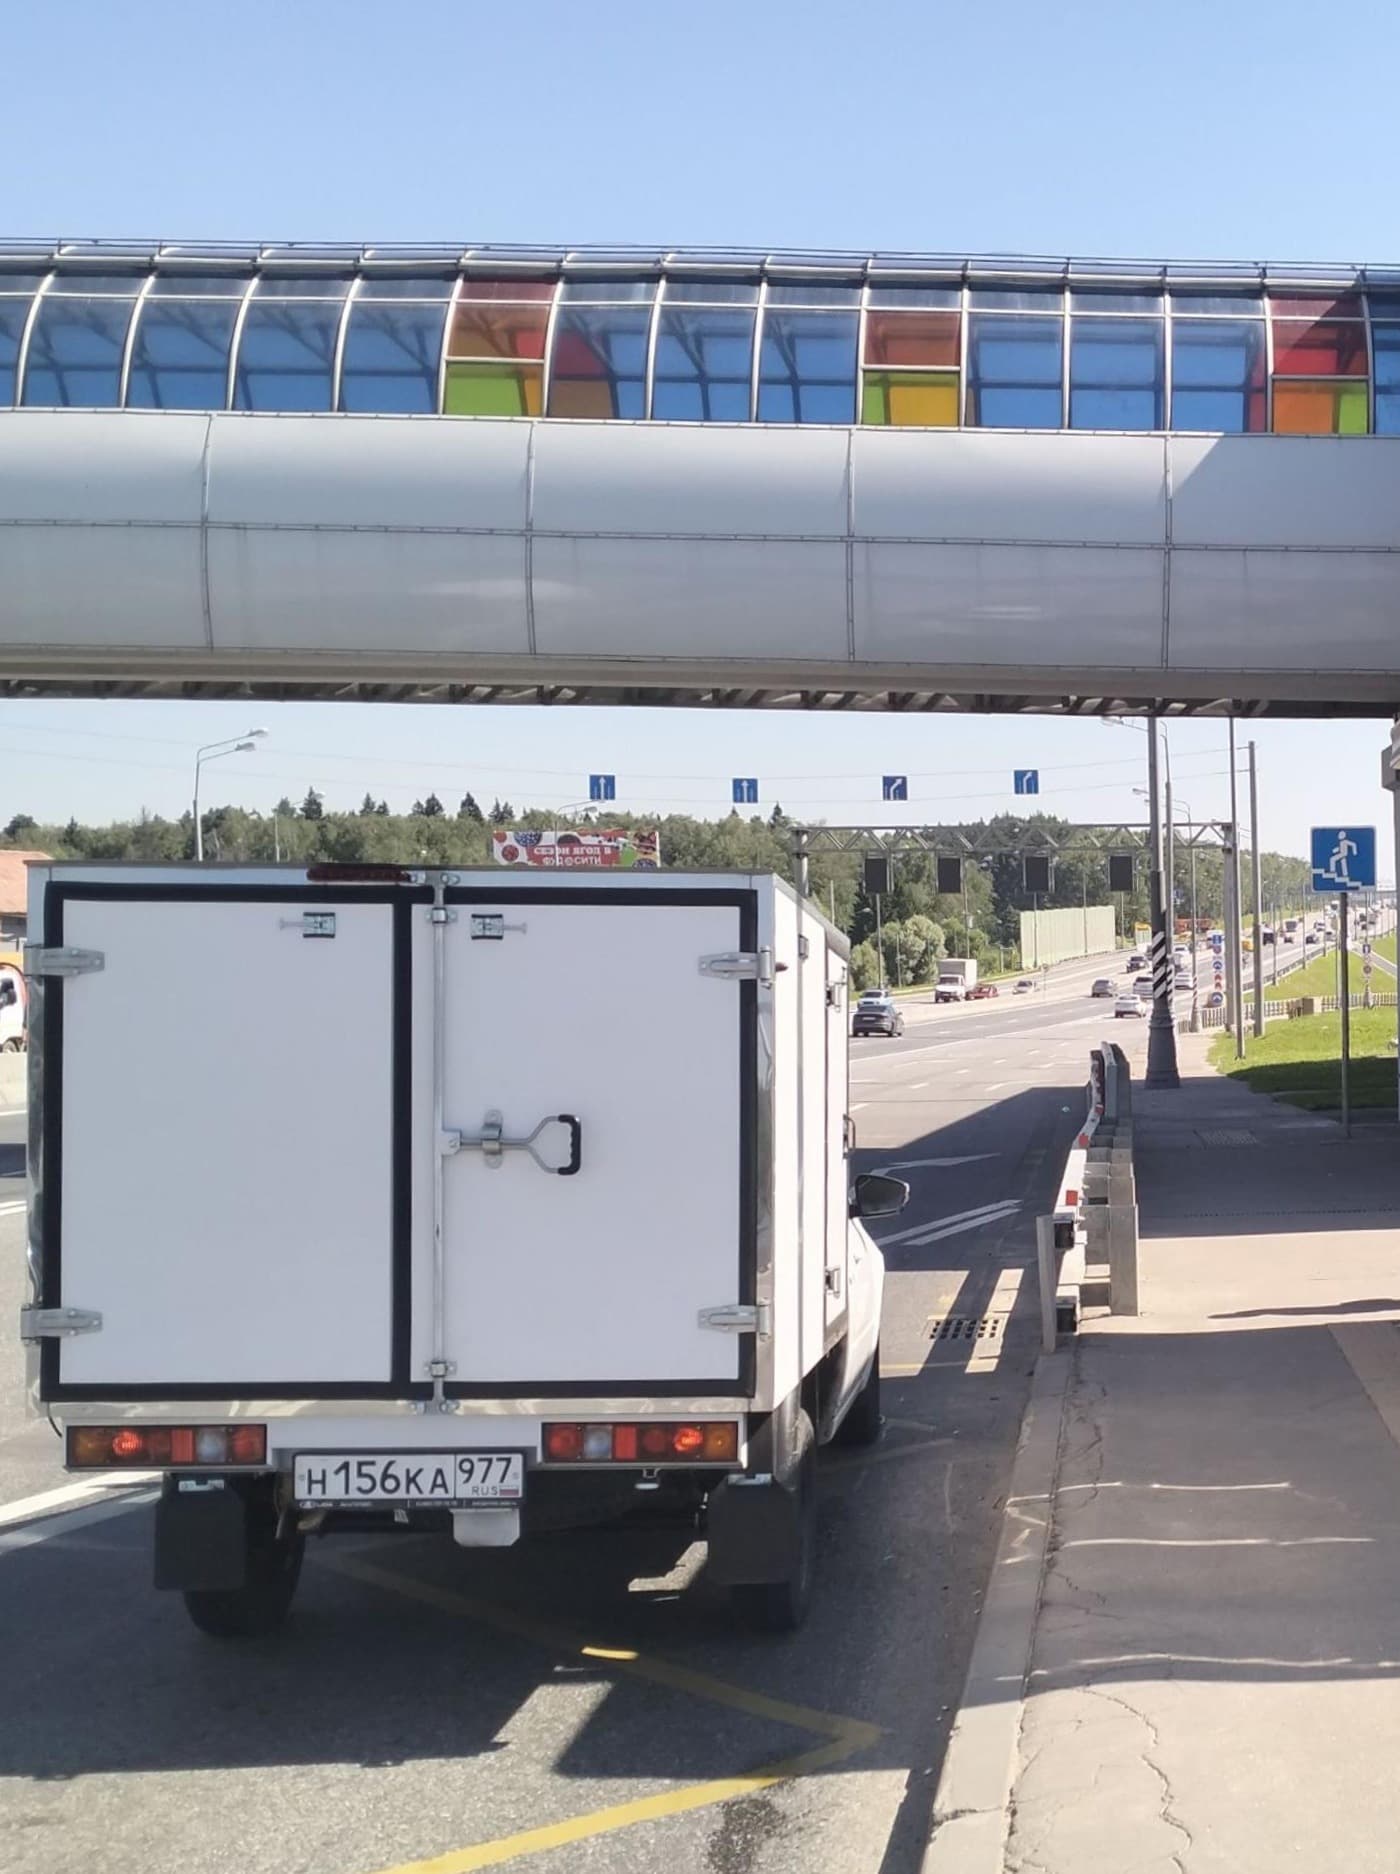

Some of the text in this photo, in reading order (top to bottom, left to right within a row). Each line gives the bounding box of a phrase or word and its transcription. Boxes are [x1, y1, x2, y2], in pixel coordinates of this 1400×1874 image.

[306, 1456, 513, 1496] Н156КА 977
[471, 1485, 499, 1497] RUS
